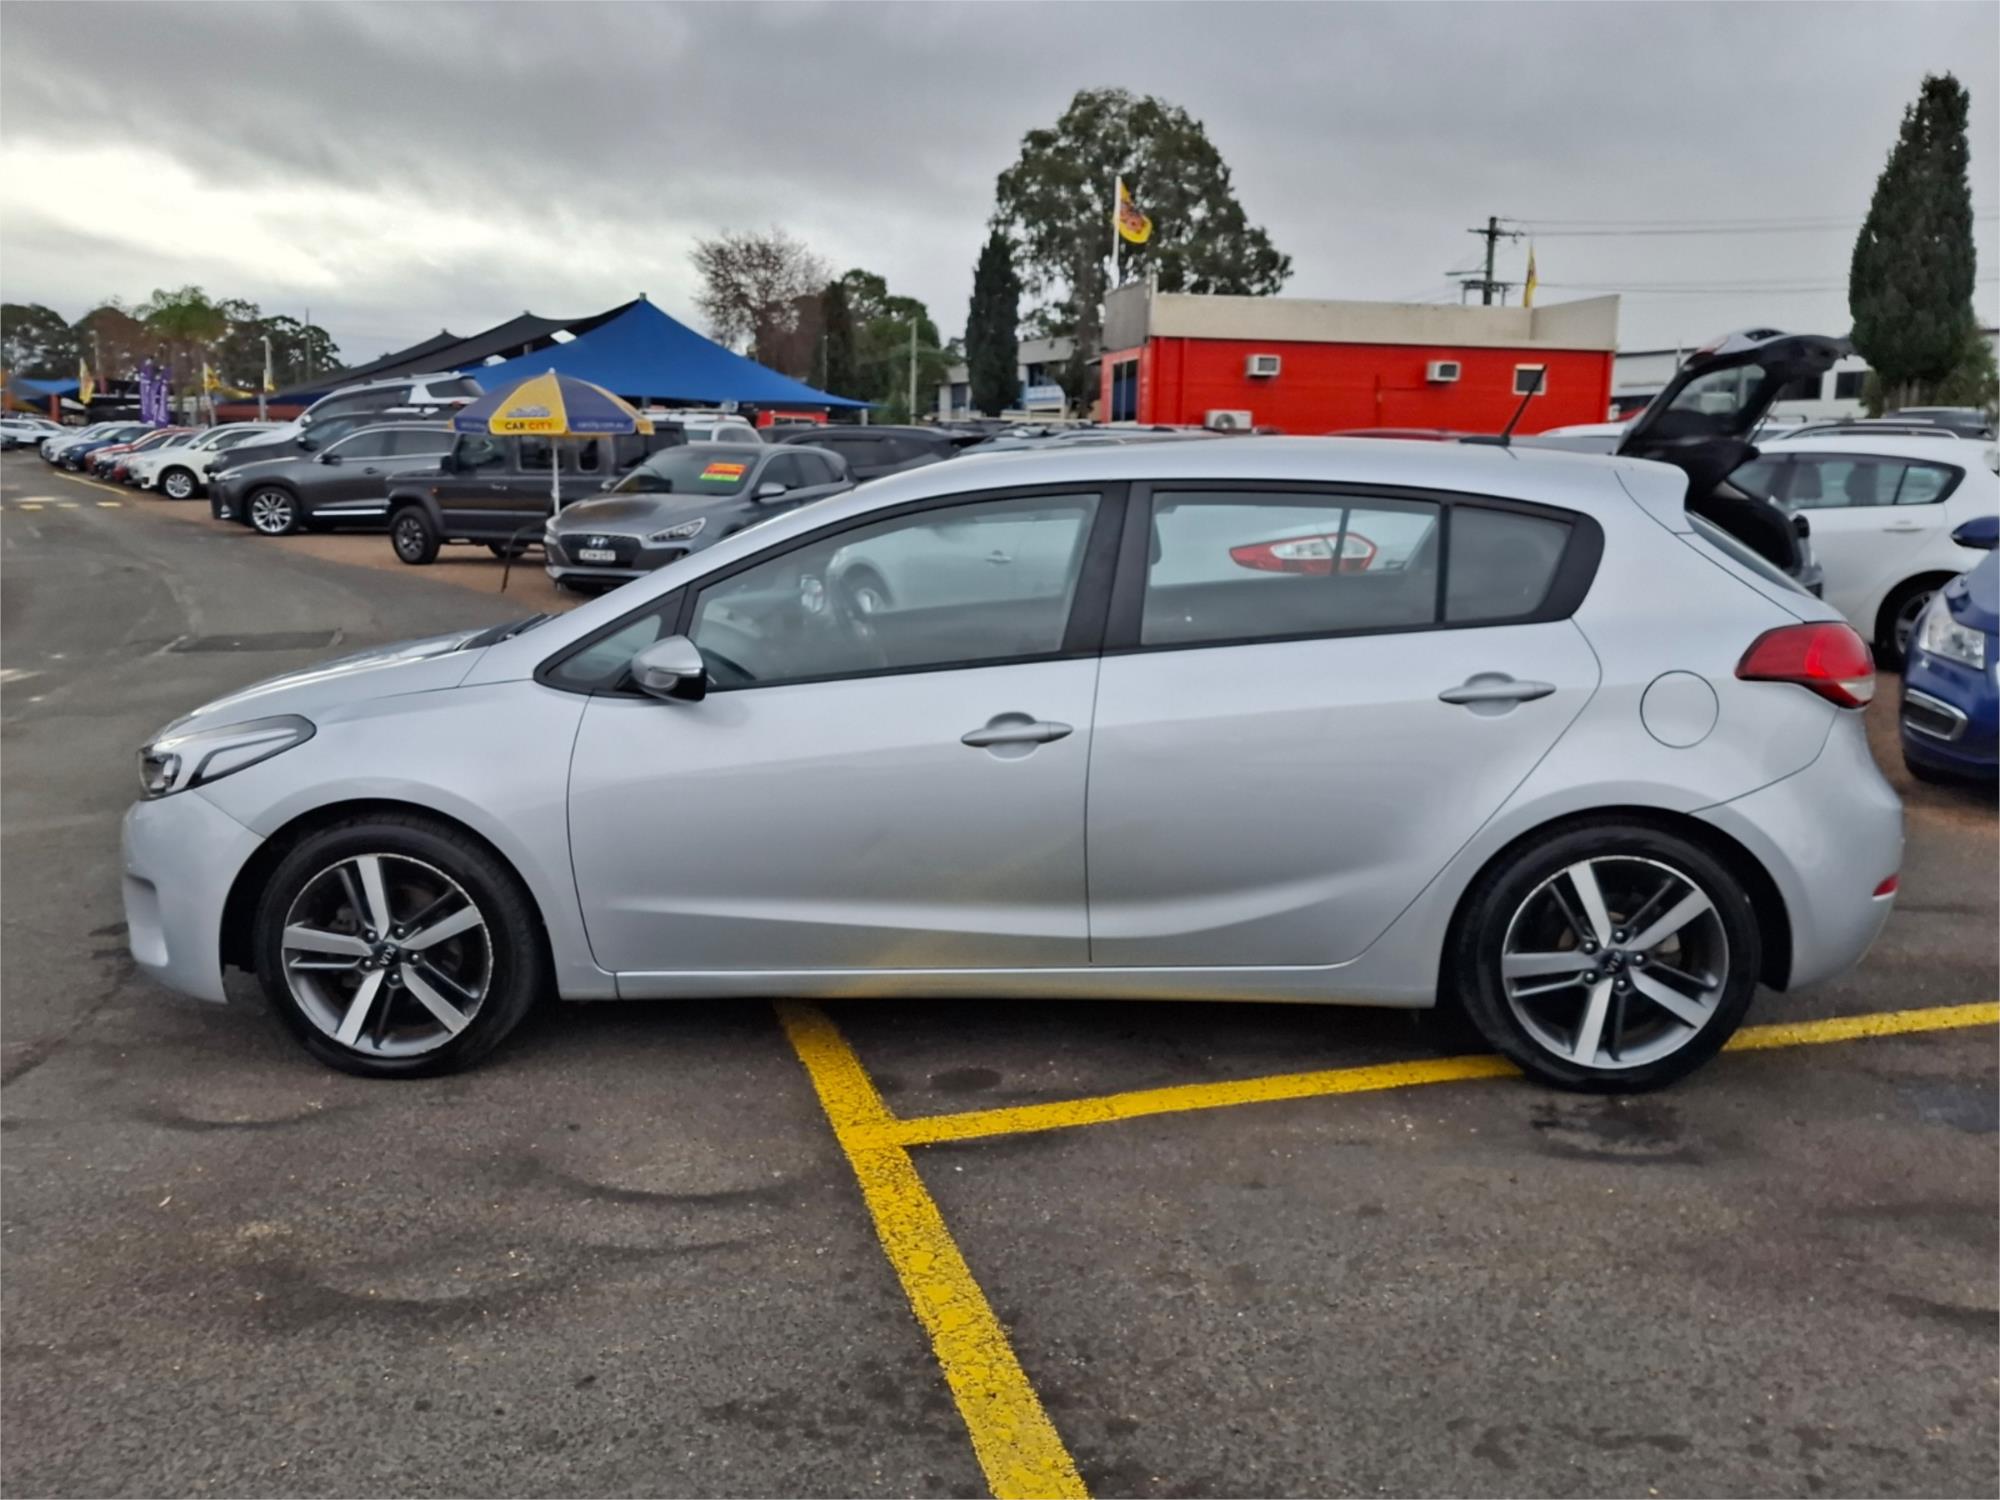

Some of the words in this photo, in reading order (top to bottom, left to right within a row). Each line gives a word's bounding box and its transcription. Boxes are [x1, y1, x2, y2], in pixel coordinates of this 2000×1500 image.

[504, 421, 525, 430] CAR
[528, 421, 552, 430] CITY
[379, 945, 396, 965] KIA
